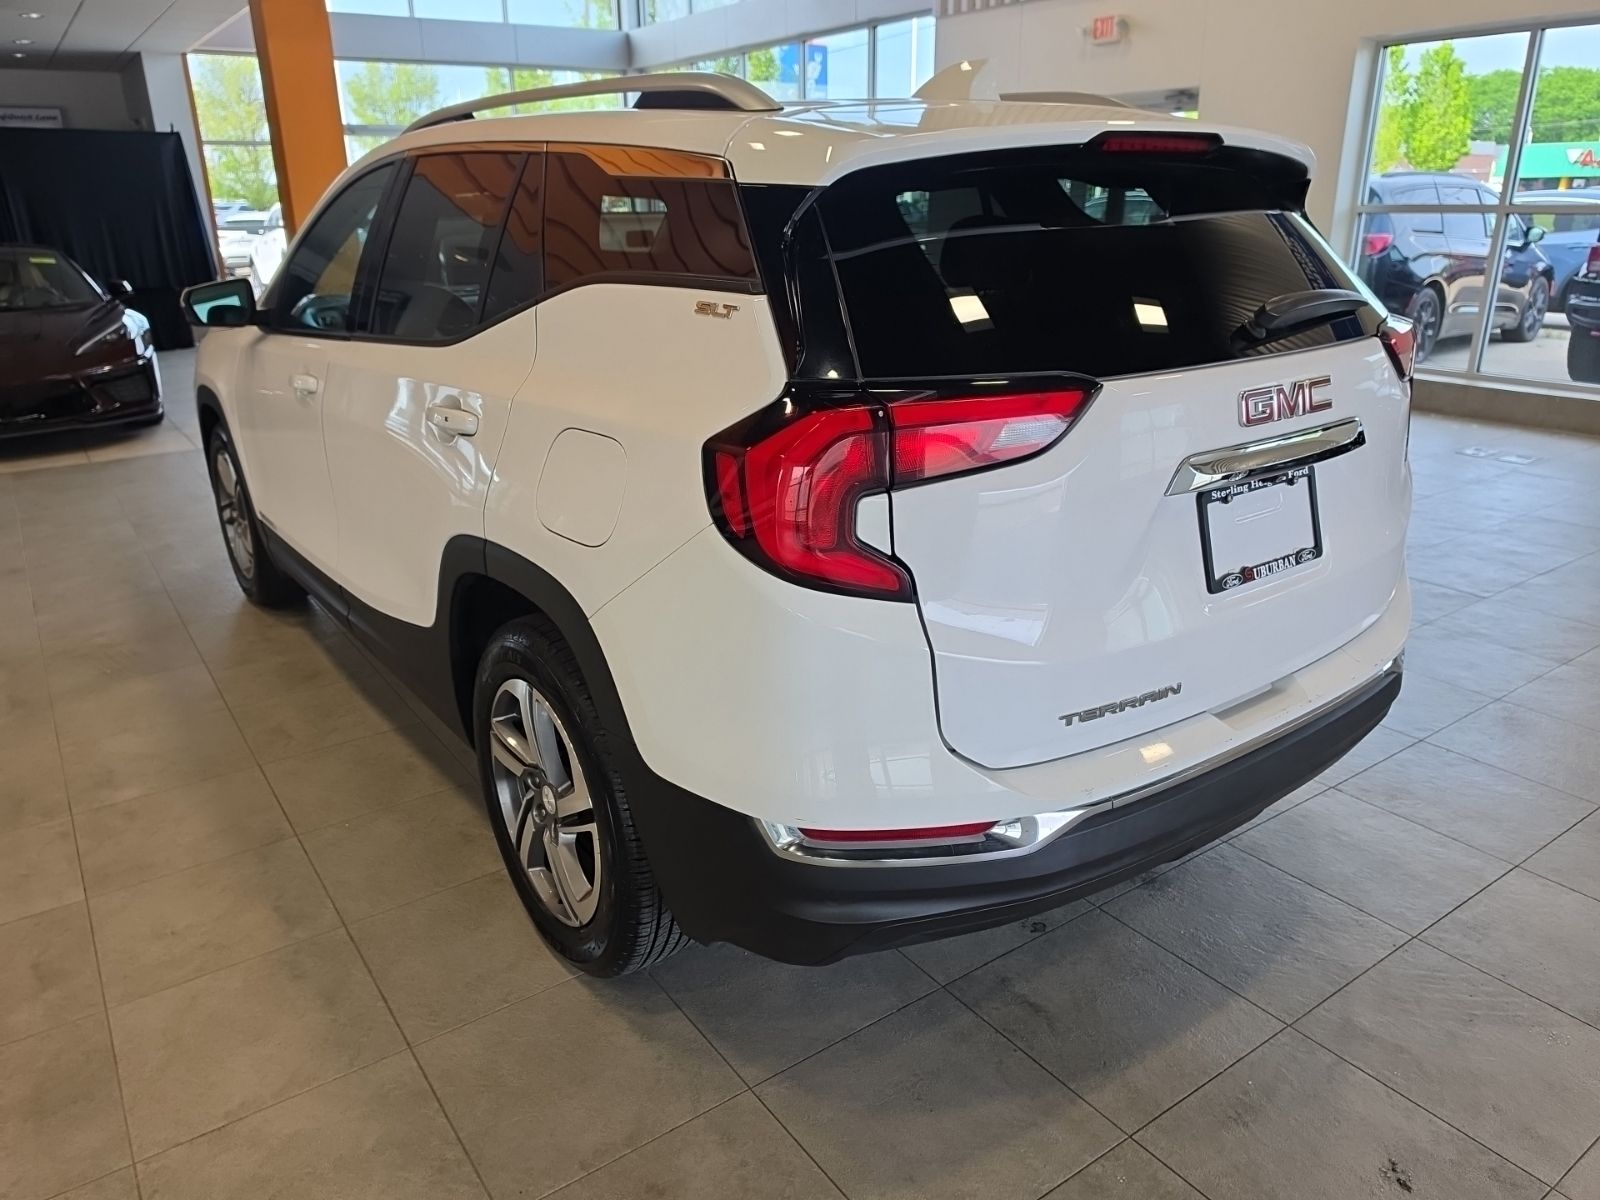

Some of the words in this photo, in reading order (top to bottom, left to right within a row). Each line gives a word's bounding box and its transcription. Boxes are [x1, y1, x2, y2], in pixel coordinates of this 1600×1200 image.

[1092, 16, 1115, 40] EXIT
[694, 300, 740, 320] SLT
[1238, 375, 1333, 428] GMC
[1287, 466, 1309, 479] Ford
[1211, 484, 1249, 500] Sterling
[1058, 682, 1182, 727] TERRAIN
